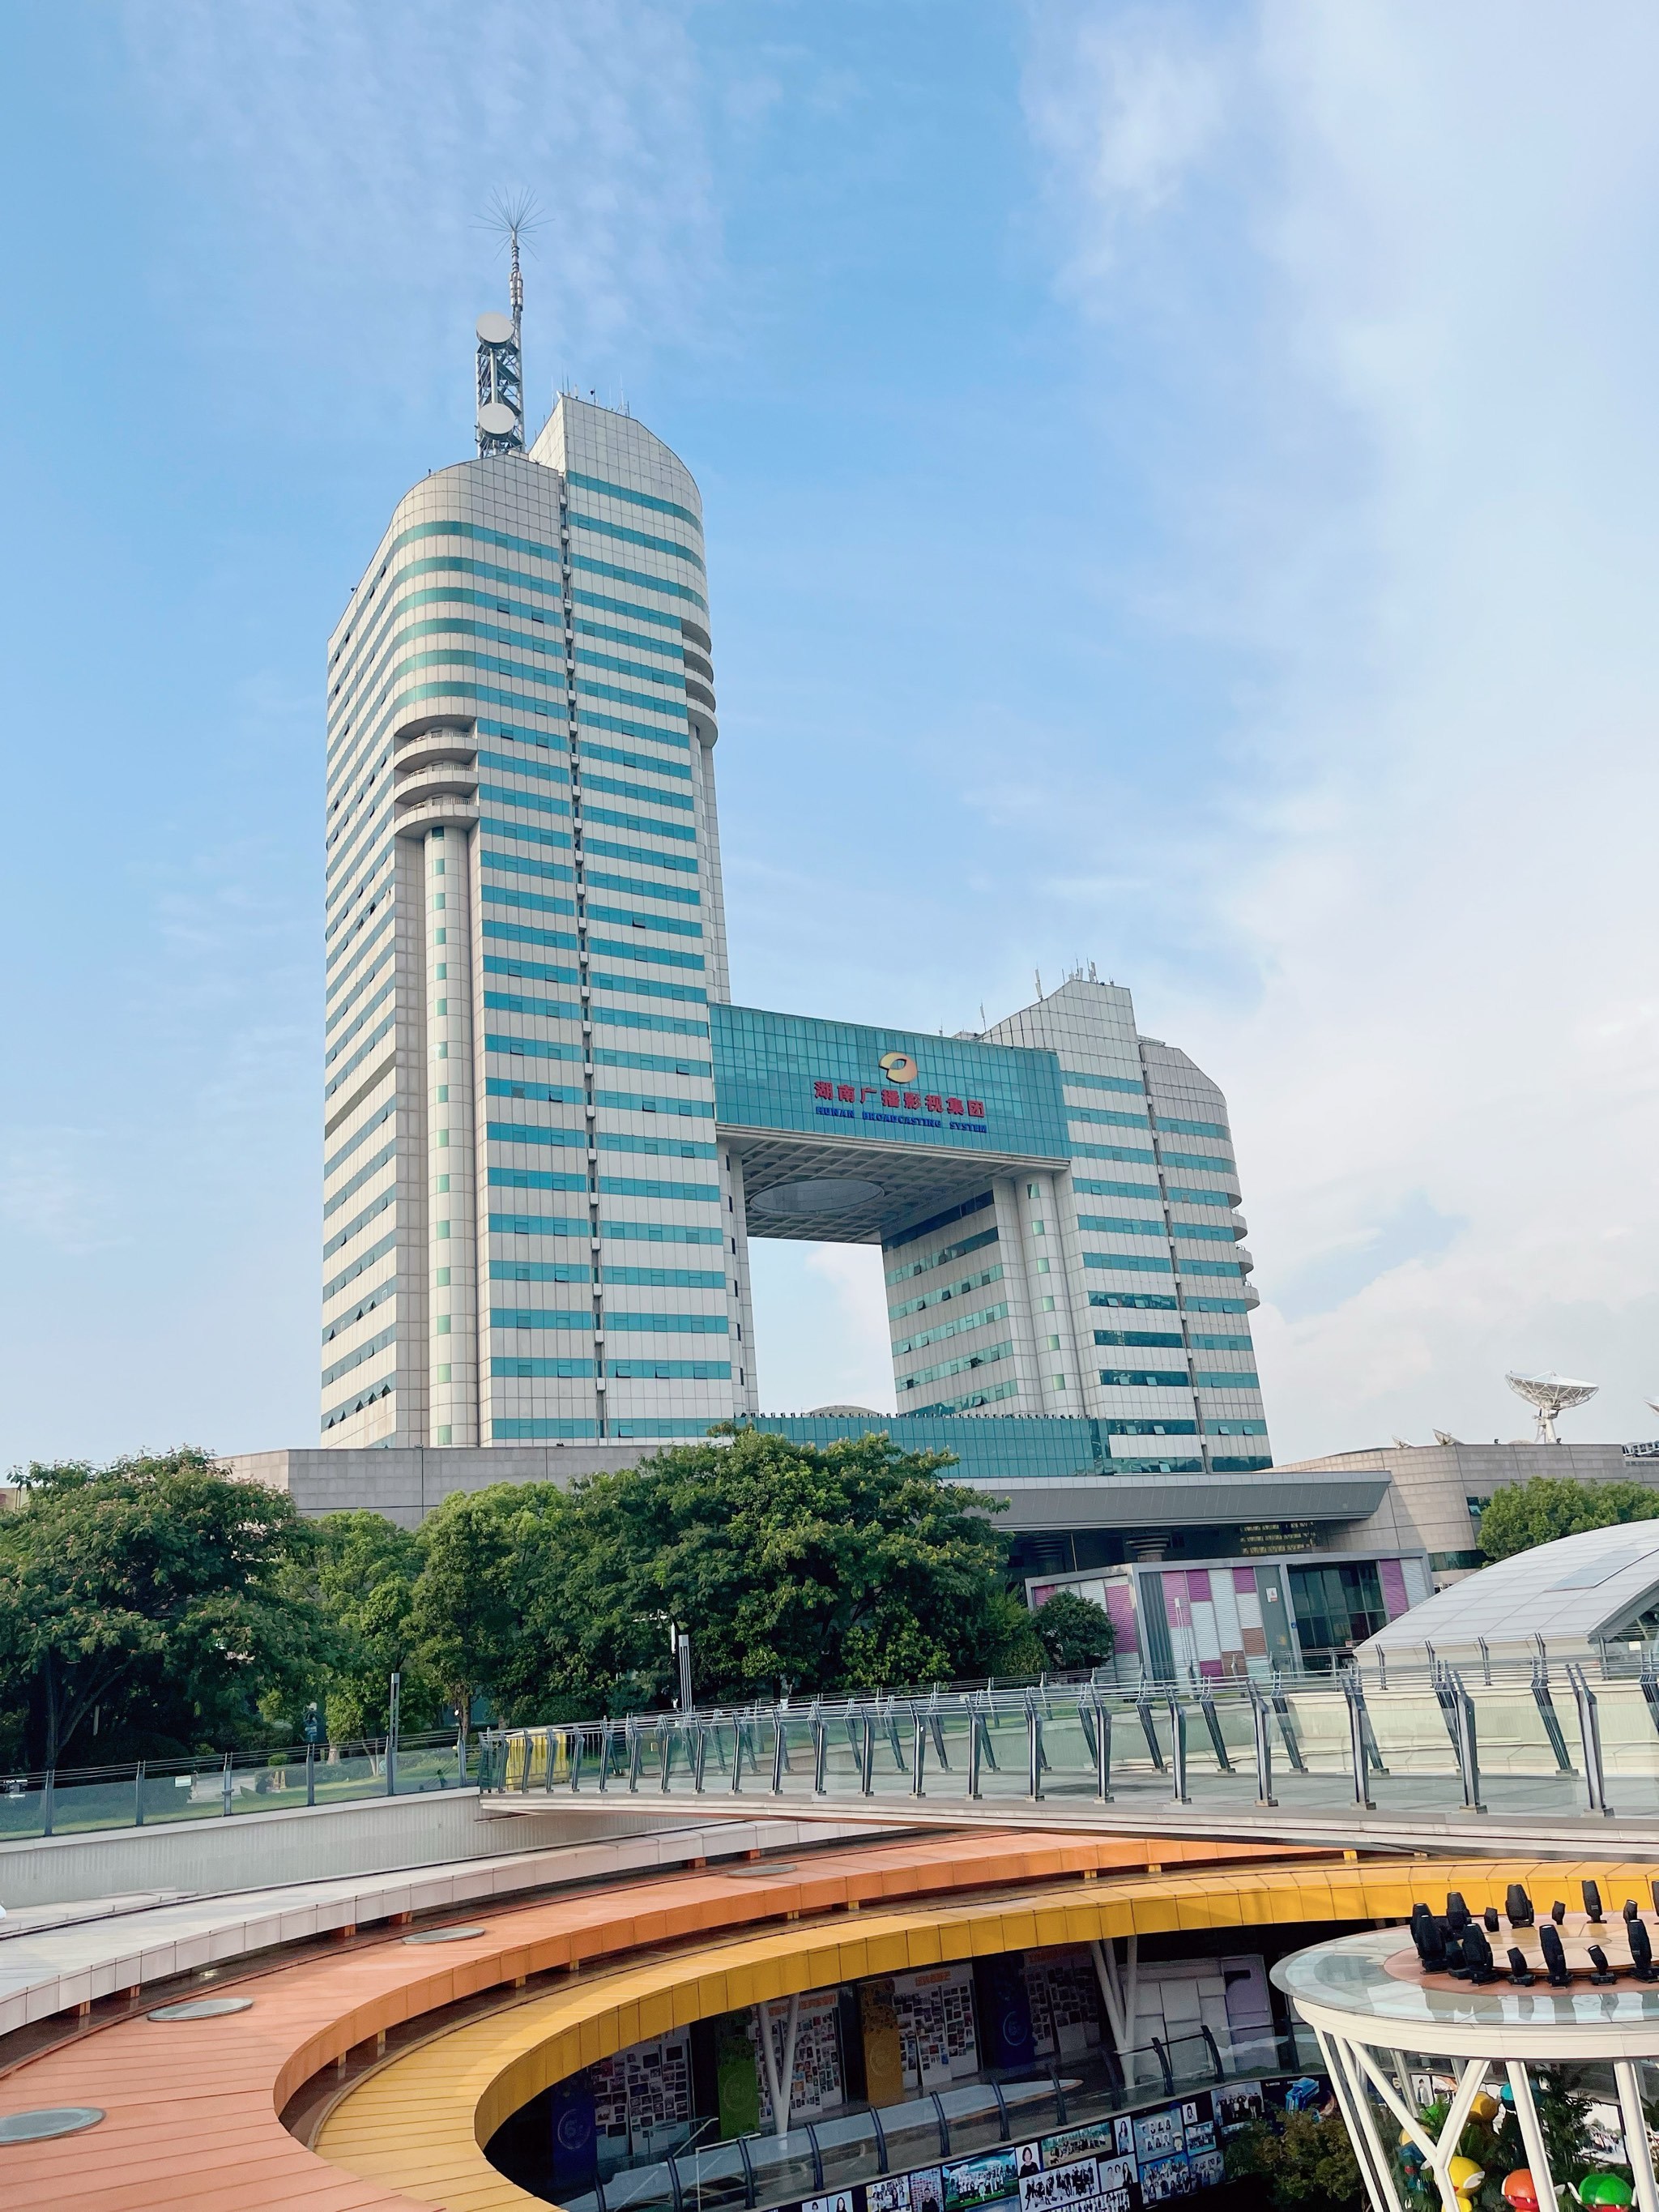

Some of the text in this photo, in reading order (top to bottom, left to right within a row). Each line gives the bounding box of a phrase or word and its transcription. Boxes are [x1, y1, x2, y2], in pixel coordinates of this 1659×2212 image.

[814, 1082, 984, 1117] 湖南广播影视集团
[816, 1107, 987, 1133] HUNAN BROADCASTING SYSTEM
